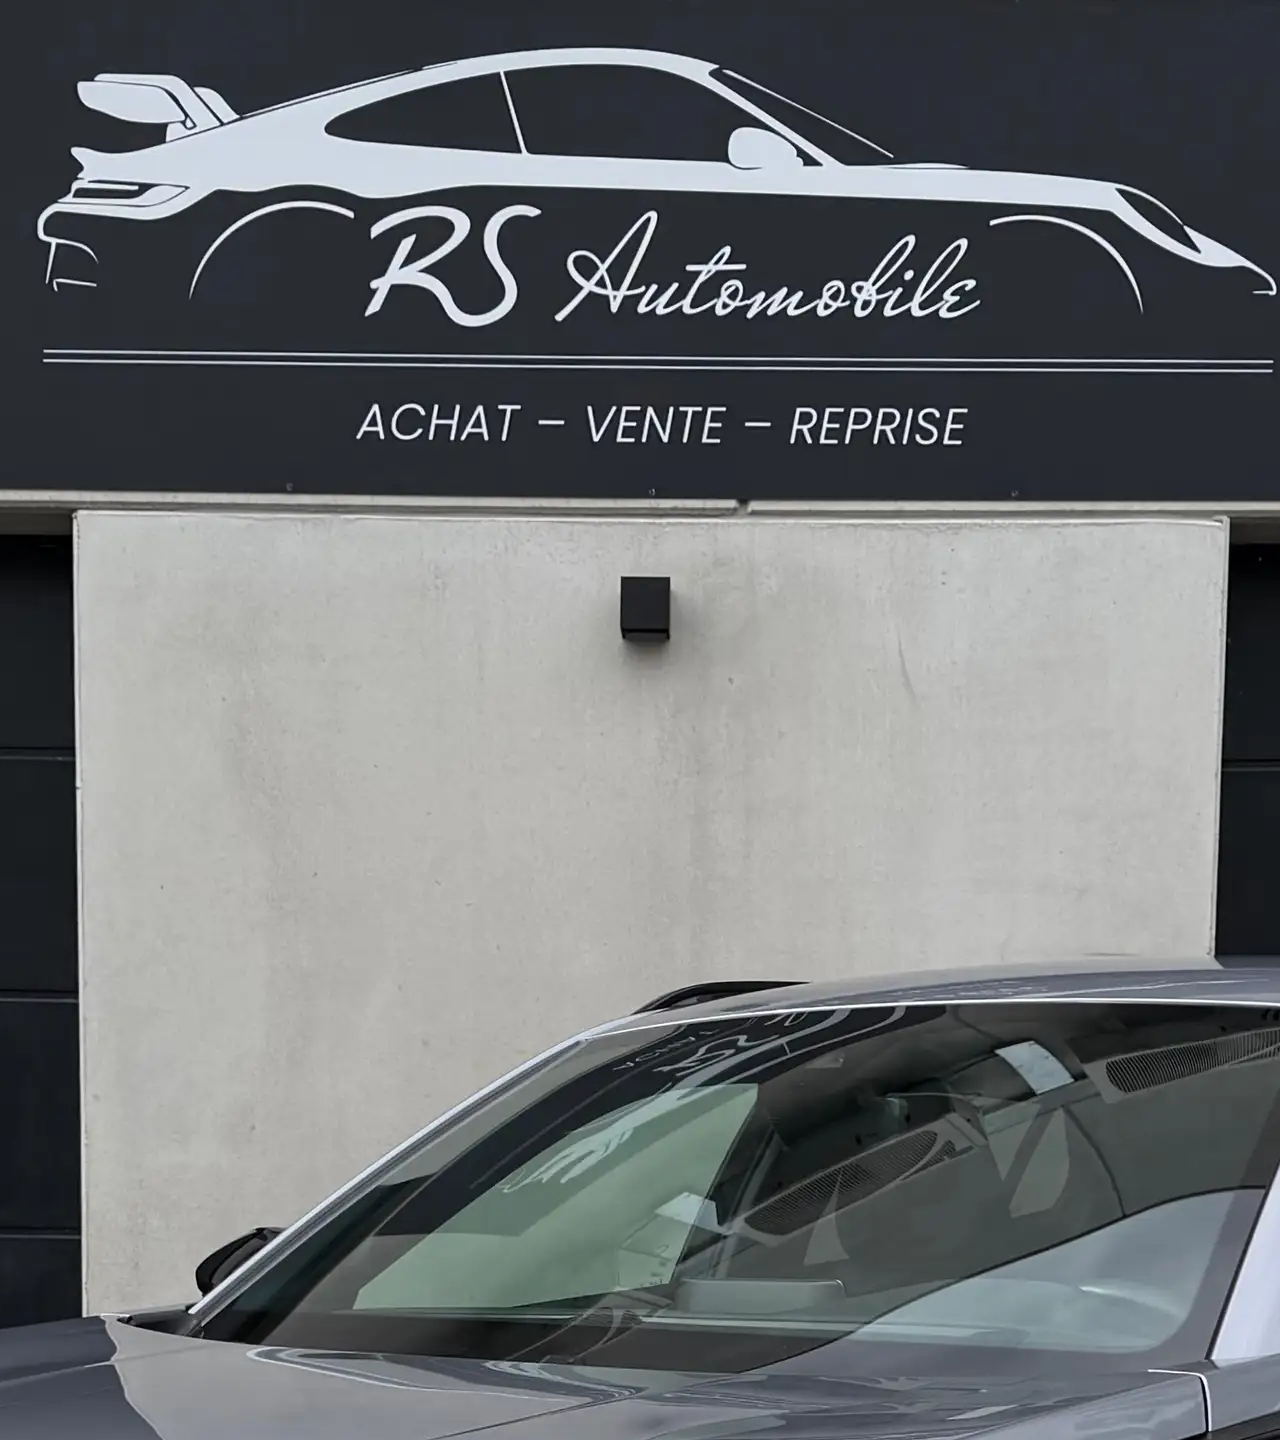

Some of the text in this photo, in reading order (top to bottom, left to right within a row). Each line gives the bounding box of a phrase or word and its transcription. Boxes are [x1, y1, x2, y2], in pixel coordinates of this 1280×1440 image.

[365, 205, 980, 327] RS Automobile
[356, 404, 521, 442] ACHAT
[586, 406, 726, 444] VENTE
[789, 407, 968, 446] REPRISE
